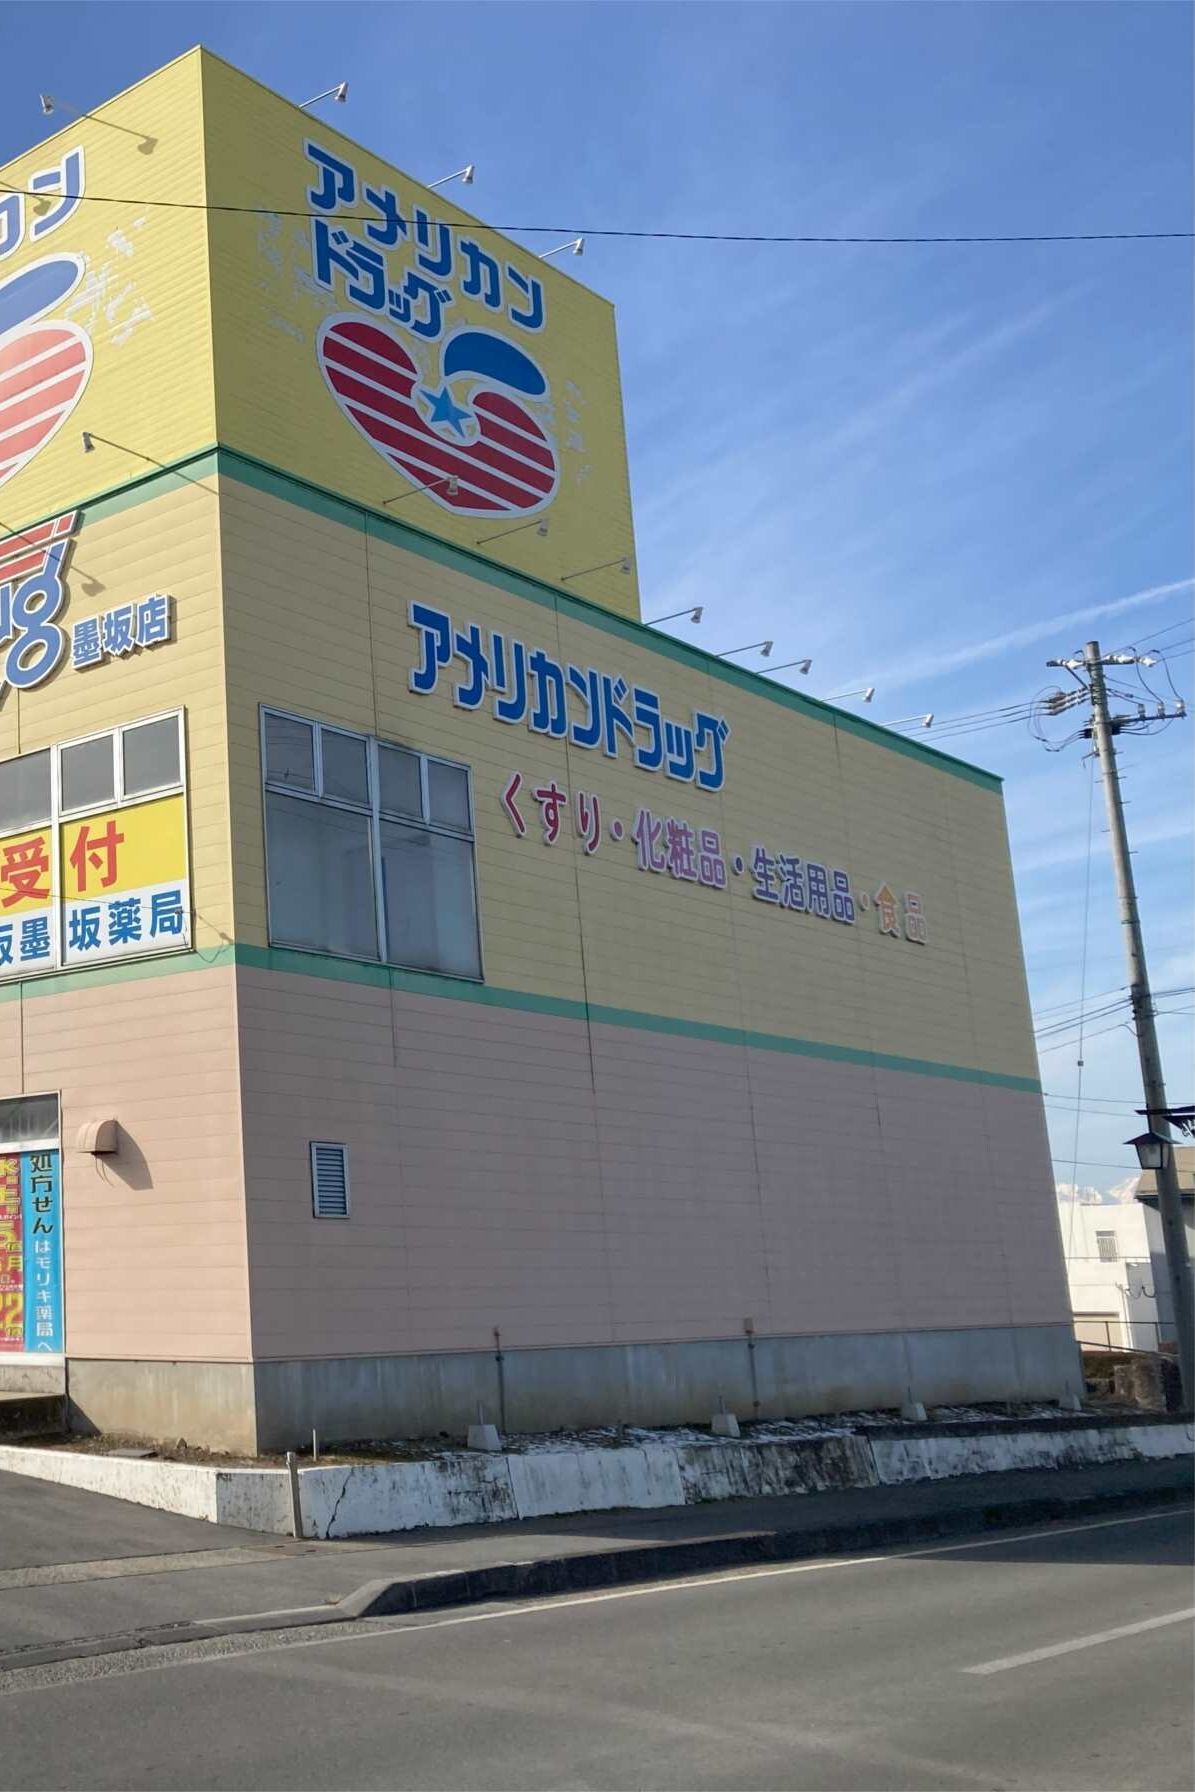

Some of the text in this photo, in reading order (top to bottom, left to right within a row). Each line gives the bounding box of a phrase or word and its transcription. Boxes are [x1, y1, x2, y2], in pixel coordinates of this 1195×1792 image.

[304, 138, 547, 332] アメリカン
[313, 218, 455, 342] ドラッグ
[72, 594, 175, 670] 墨坂店
[408, 600, 730, 793] アメリカンドラッグ
